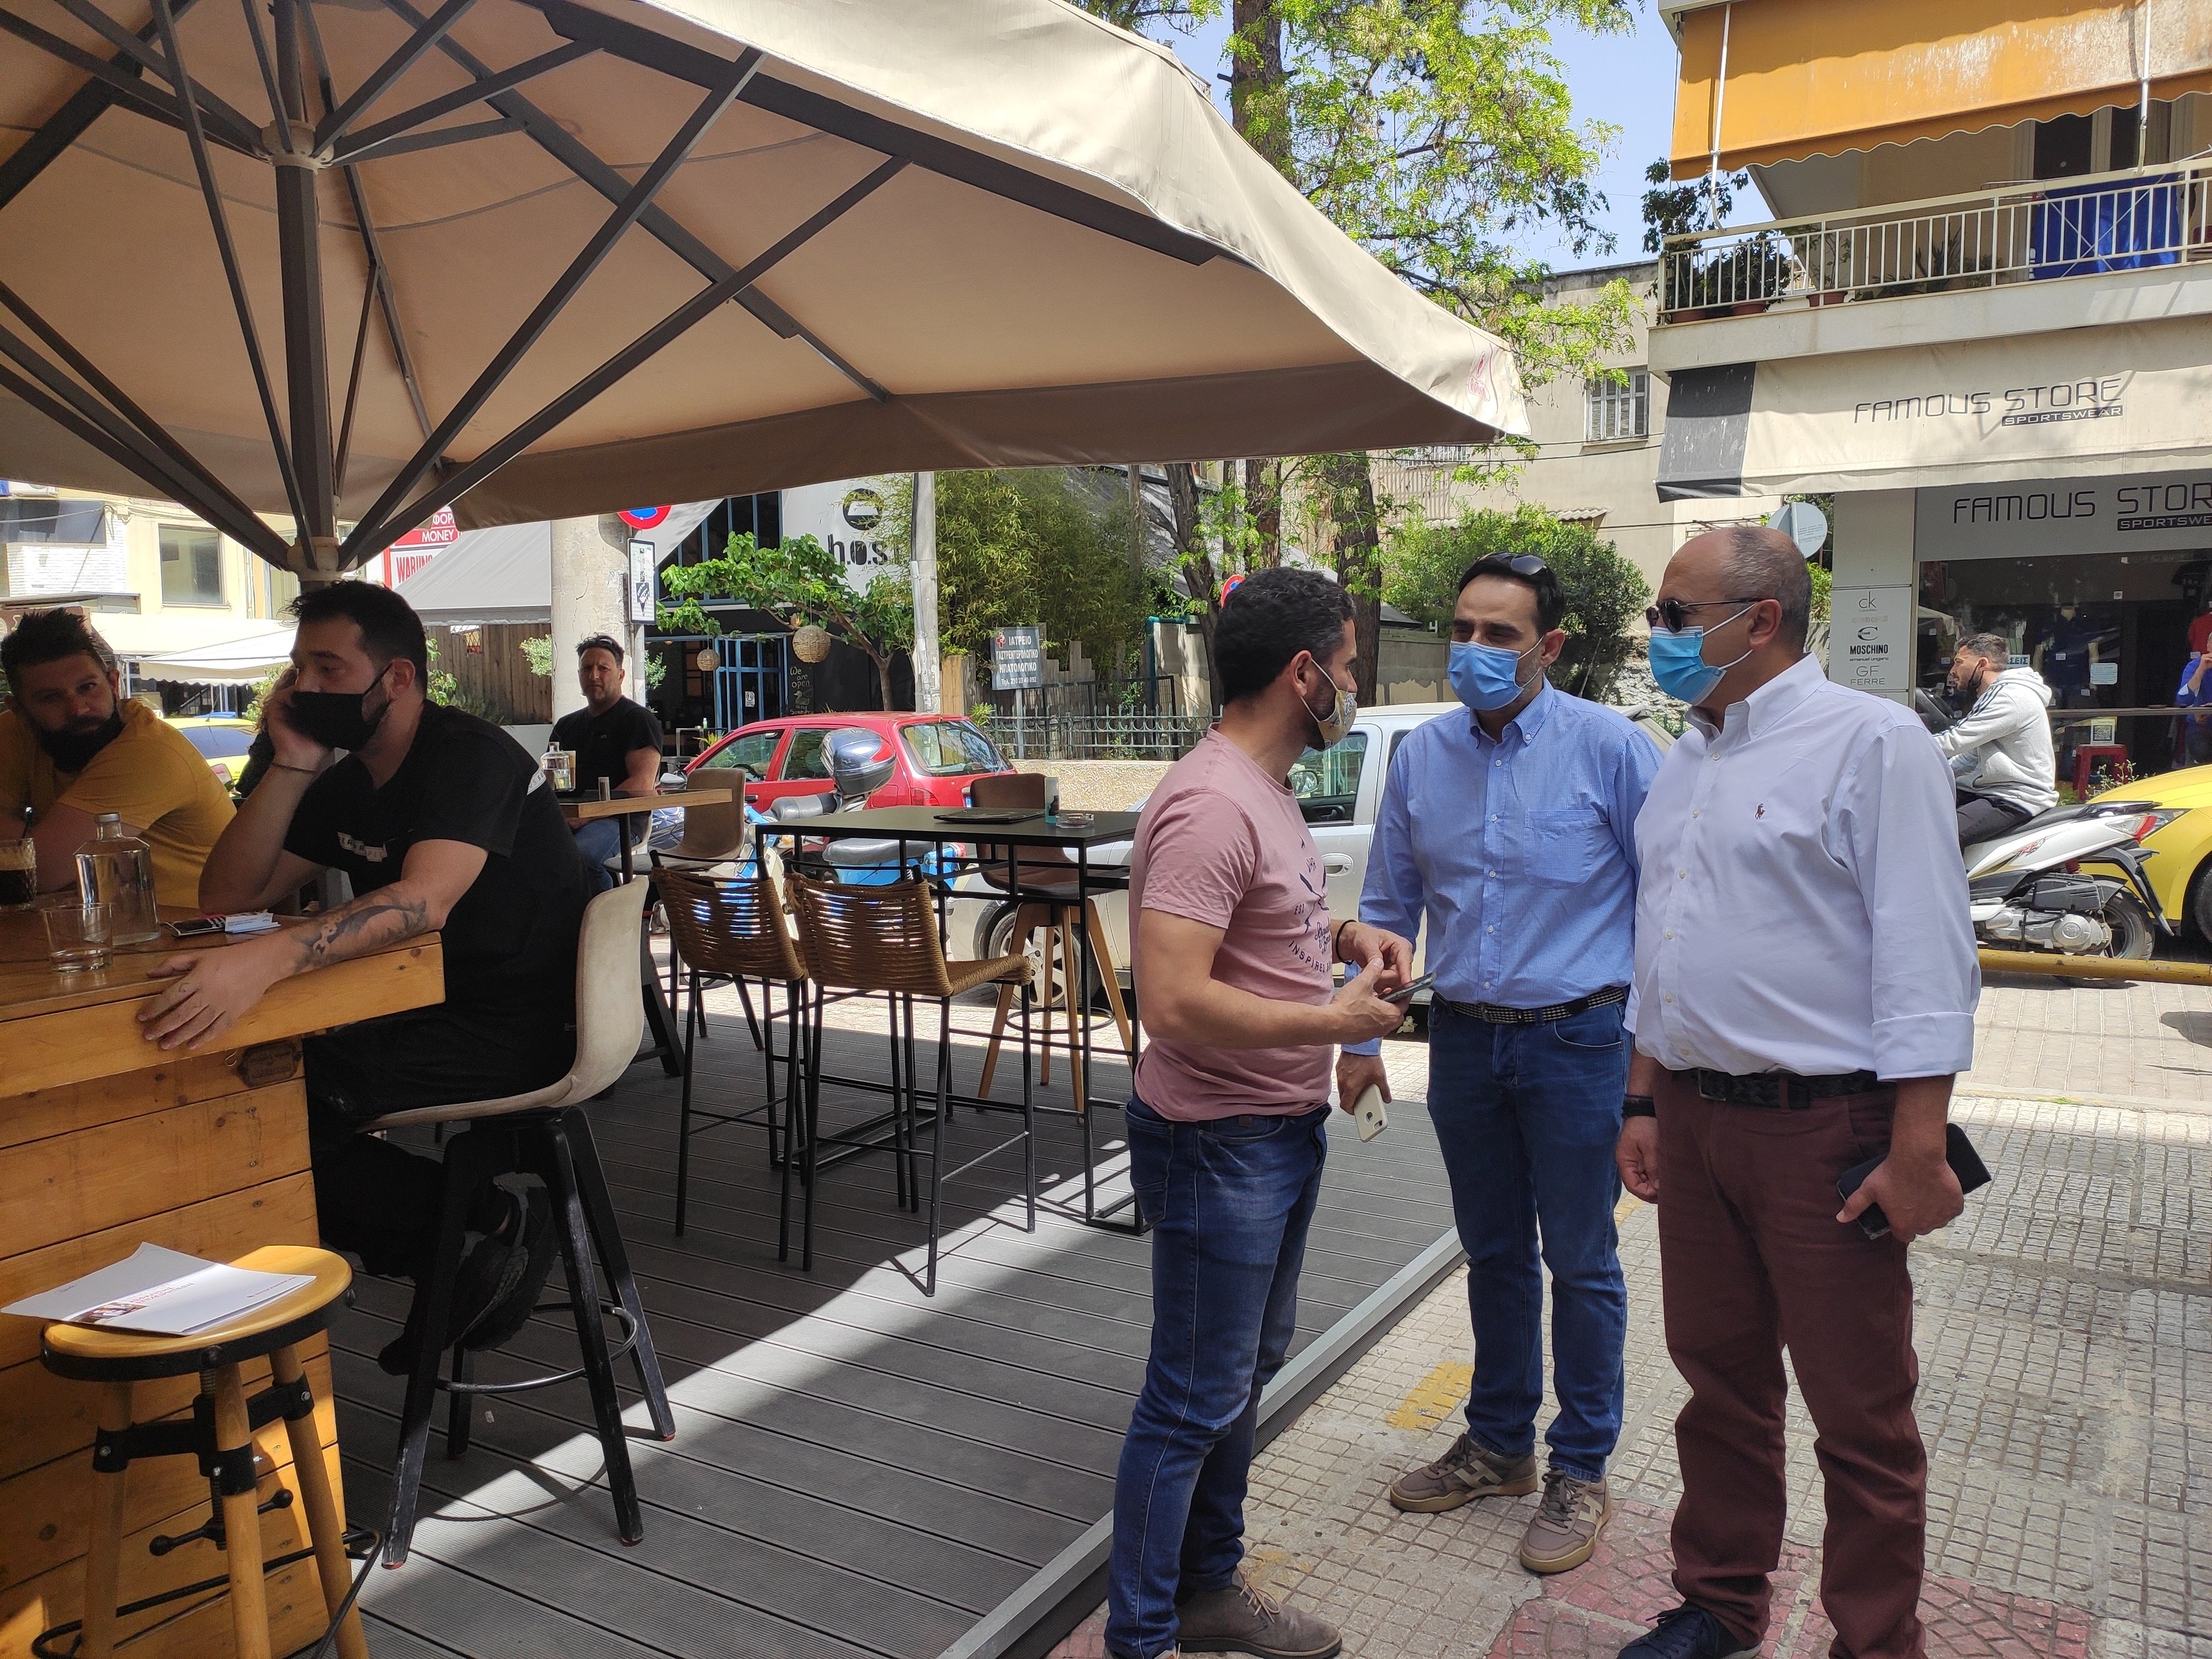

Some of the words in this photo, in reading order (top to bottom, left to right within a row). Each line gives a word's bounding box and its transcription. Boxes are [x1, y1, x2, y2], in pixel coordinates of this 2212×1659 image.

[1854, 392, 1991, 424] FAMOUS
[2005, 378, 2122, 411] STORE
[2004, 406, 2123, 426] SPORTSWEAR
[1954, 491, 2095, 524] FAMOUS
[422, 529, 454, 542] MONEY
[1859, 591, 1877, 609] ck
[1009, 635, 1031, 646] ΙΑΤΡΕΙΟ
[790, 666, 802, 675] We
[999, 662, 1036, 673] ΗΠΑΤΟΛΟΓΙΚΟ
[1856, 665, 1880, 677] GF
[791, 680, 810, 689] open
[1288, 940, 1326, 973] INSPIRED
